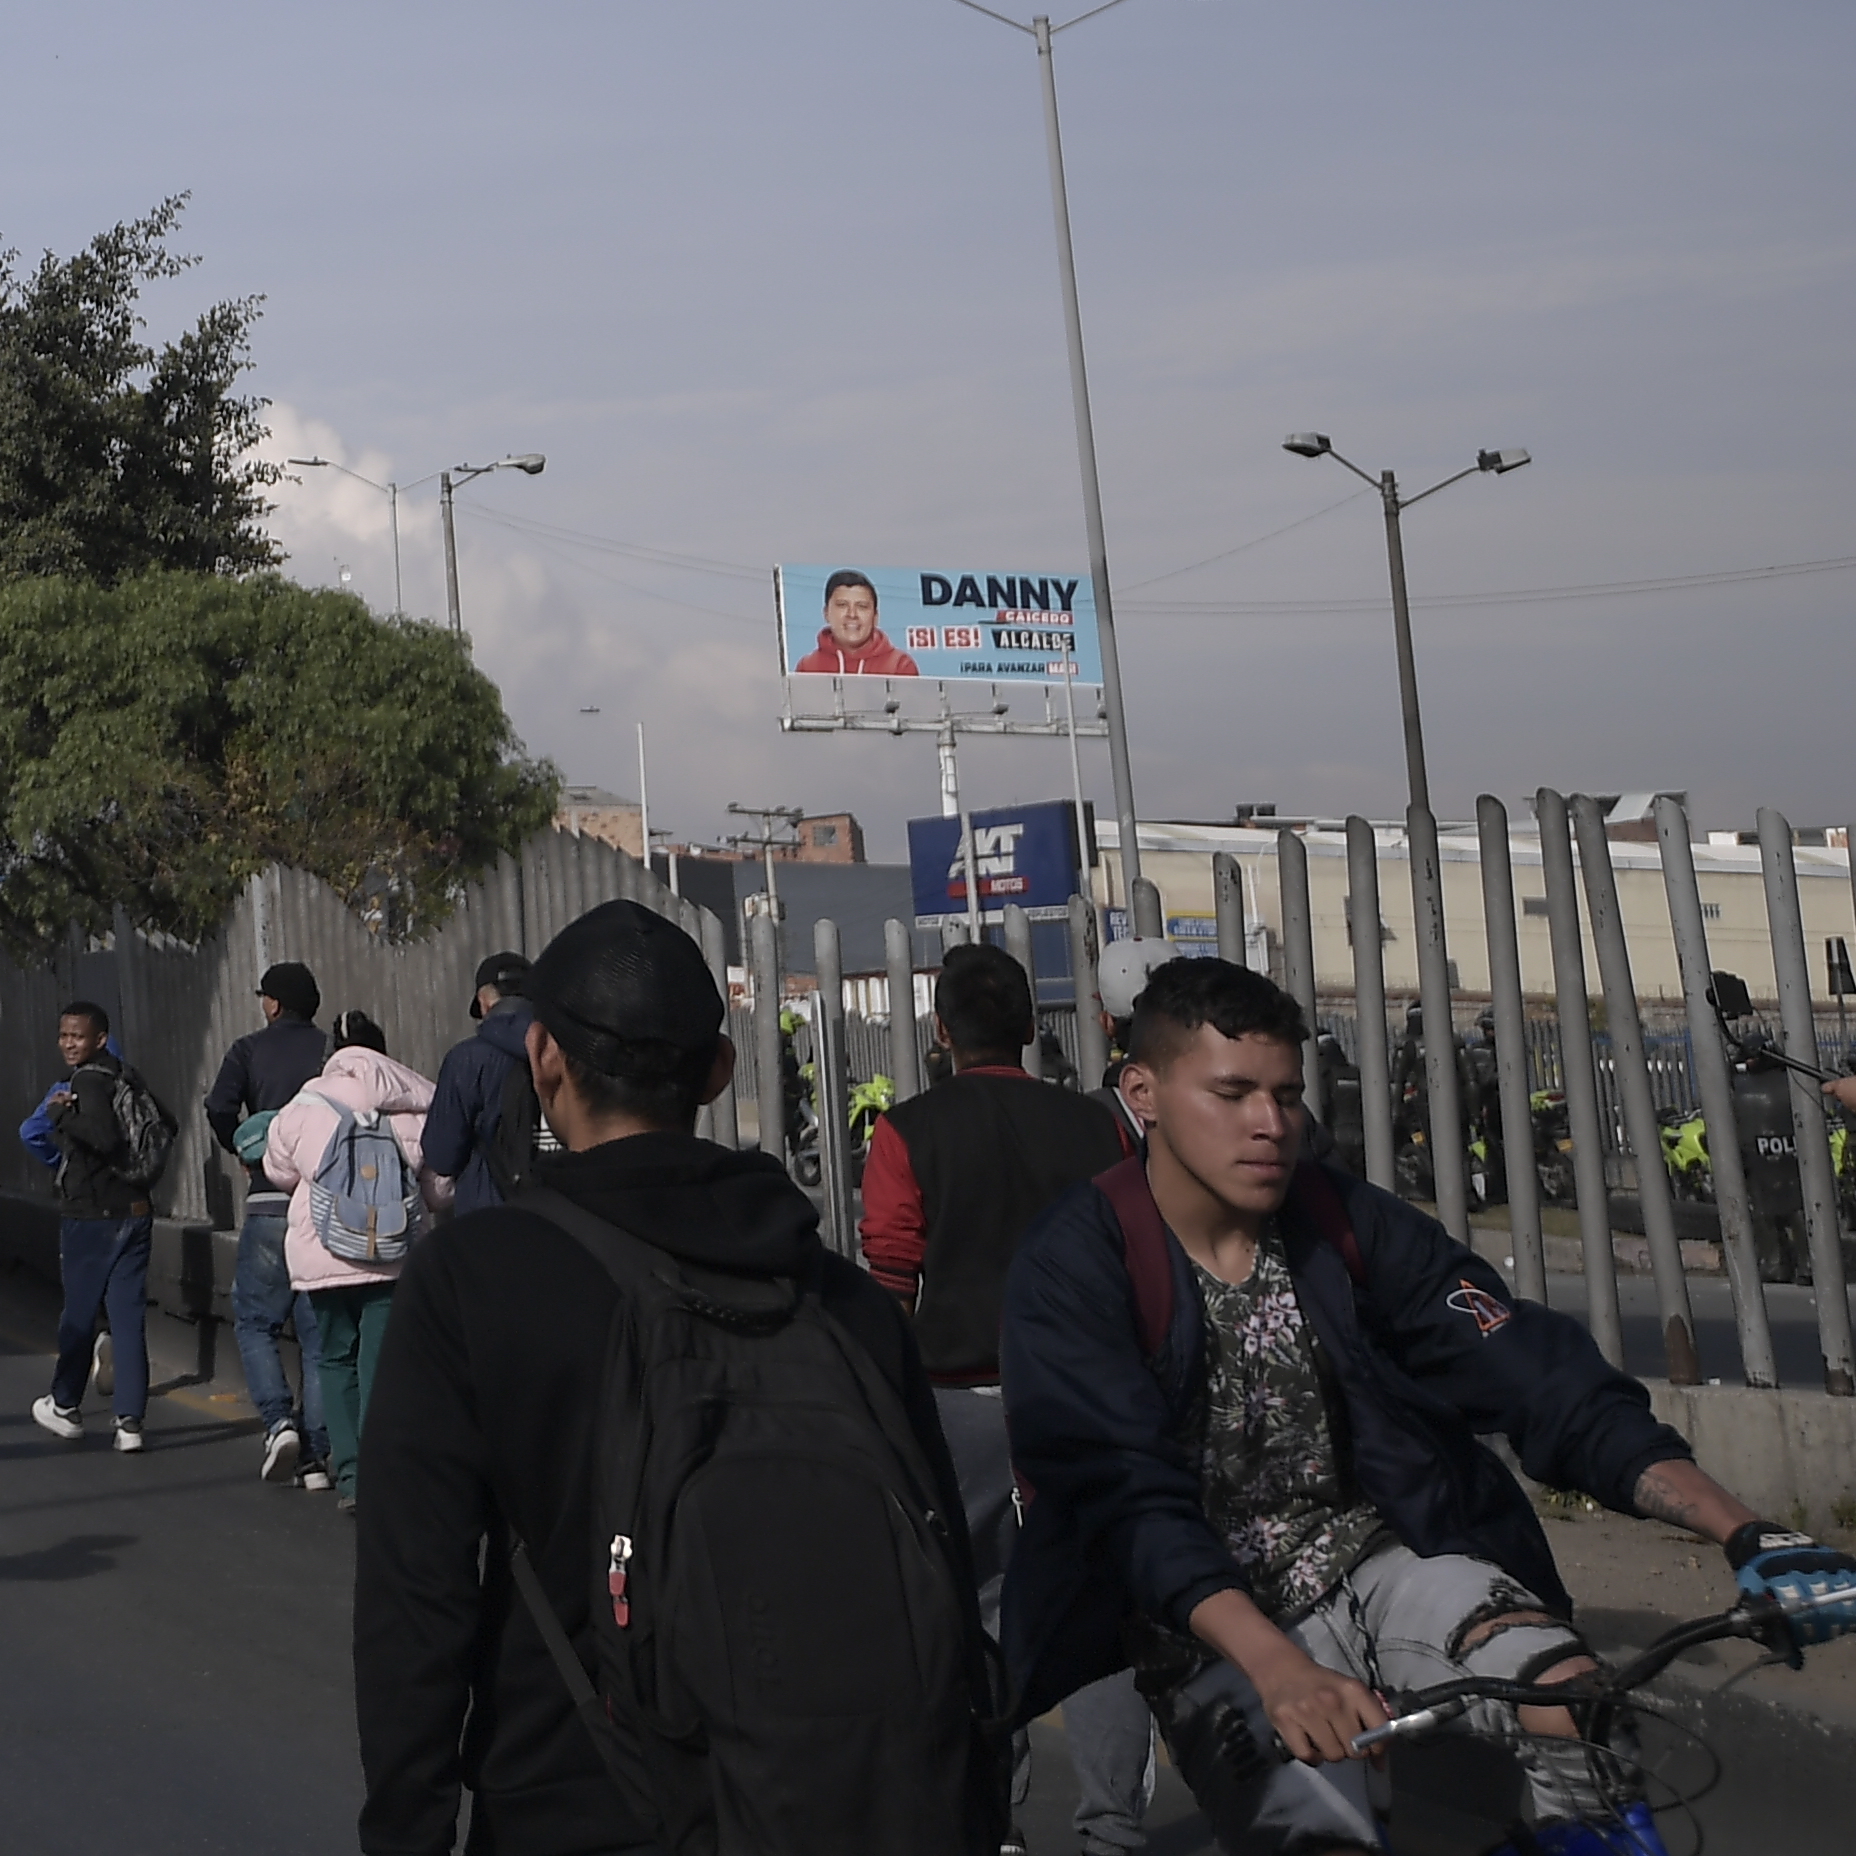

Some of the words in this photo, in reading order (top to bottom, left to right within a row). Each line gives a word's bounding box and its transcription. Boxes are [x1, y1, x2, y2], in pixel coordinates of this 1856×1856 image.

[919, 572, 1079, 612] DANNY
[1005, 611, 1071, 623] CAICEDO
[943, 627, 980, 648] ES!
[999, 630, 1073, 650] ALCALDE
[996, 662, 1046, 674] AVANZAR
[990, 877, 1024, 892] MOTOS
